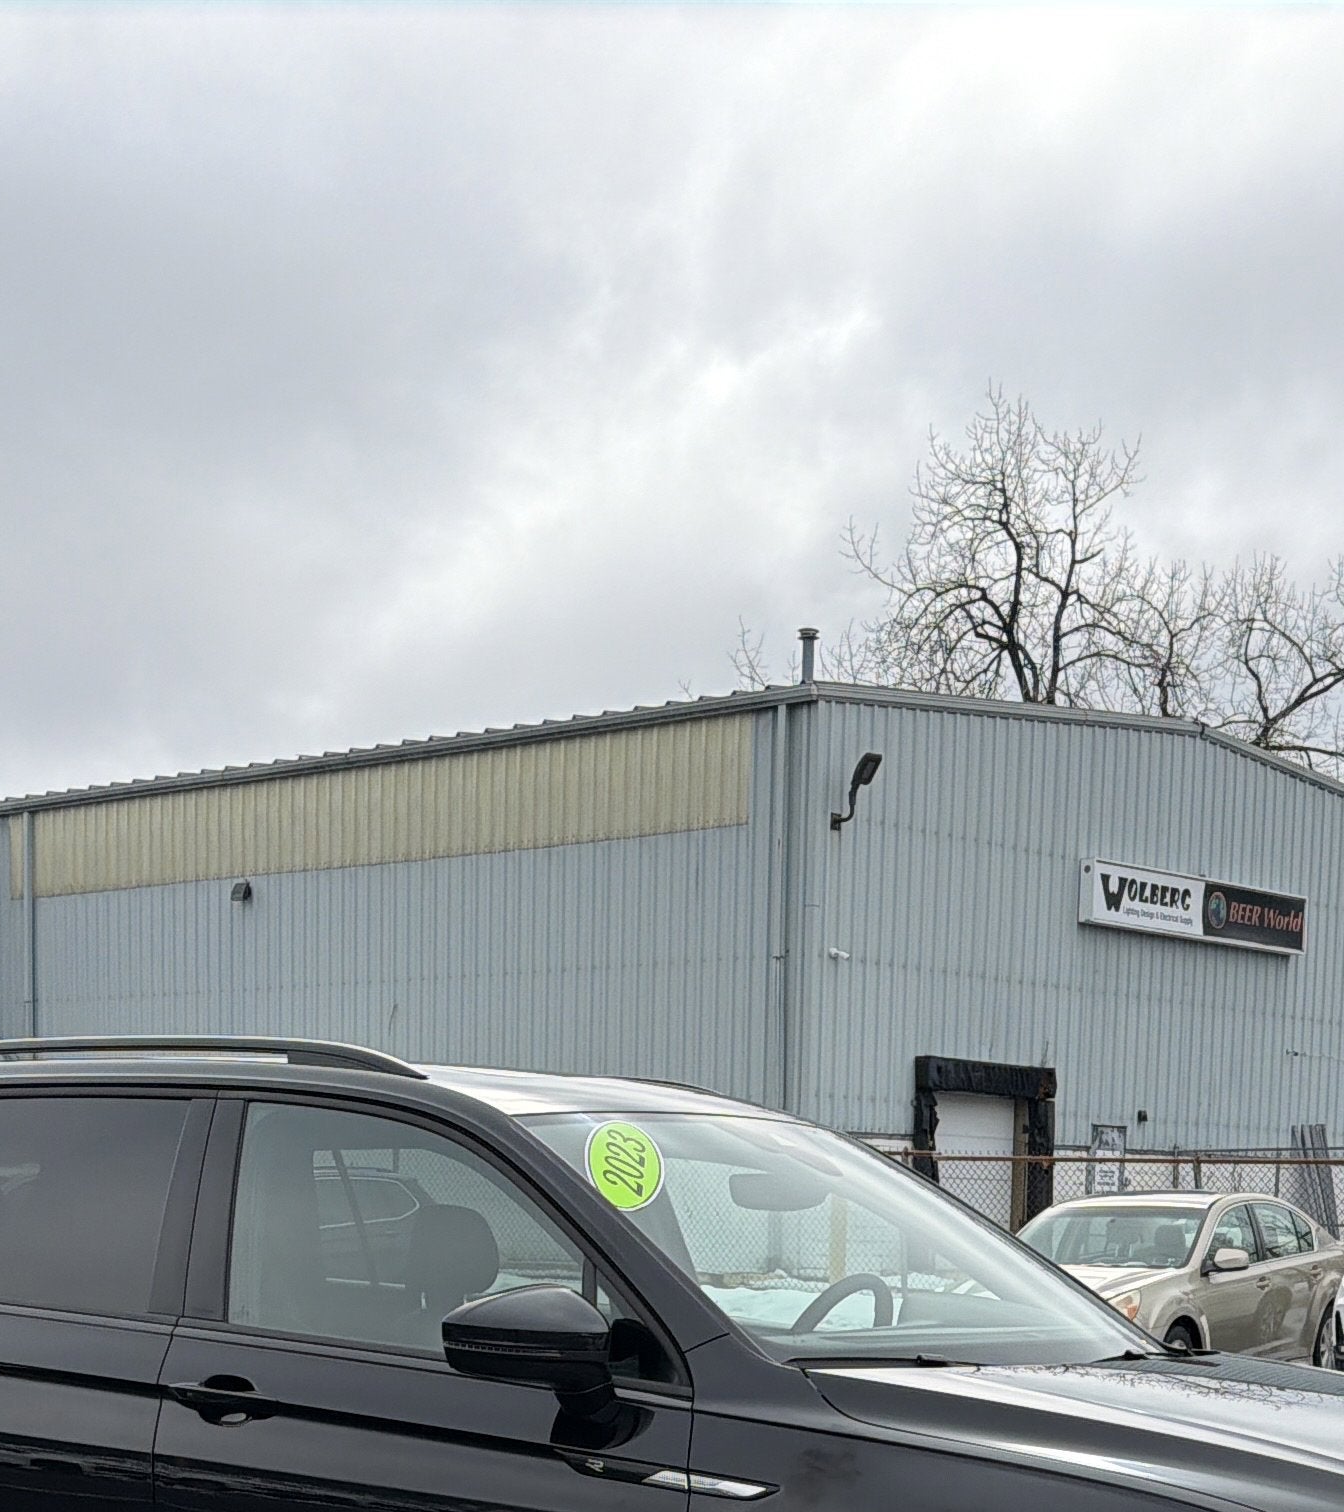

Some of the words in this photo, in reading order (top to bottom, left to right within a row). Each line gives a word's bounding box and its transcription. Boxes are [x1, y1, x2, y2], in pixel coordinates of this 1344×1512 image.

[1100, 873, 1191, 912] WOLBERG
[1229, 901, 1260, 927] BEER
[1263, 907, 1303, 933] World
[602, 1129, 646, 1198] 2023
